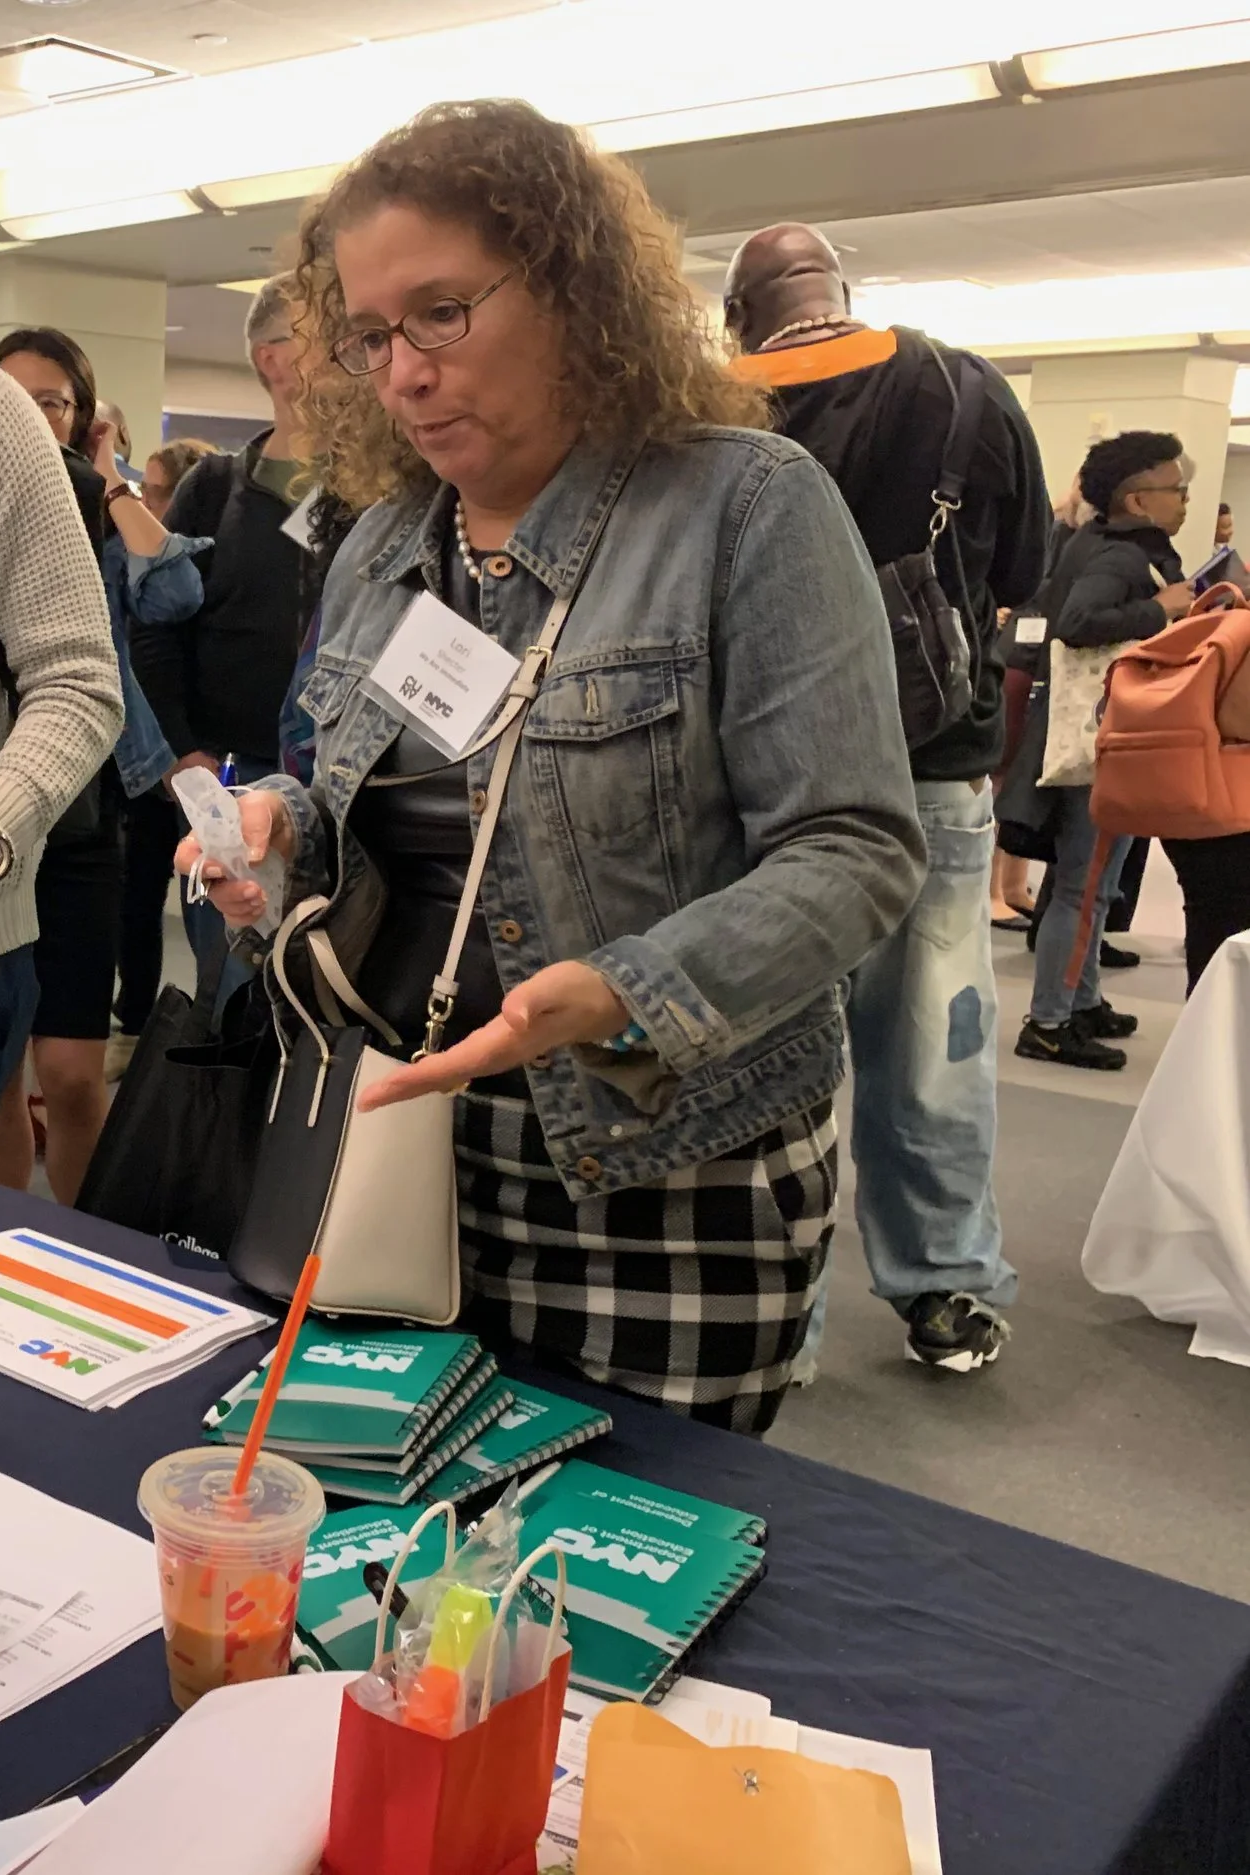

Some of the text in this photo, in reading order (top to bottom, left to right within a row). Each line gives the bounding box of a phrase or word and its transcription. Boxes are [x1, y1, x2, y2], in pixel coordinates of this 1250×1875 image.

[450, 637, 472, 658] Lori
[424, 692, 454, 718] NYC
[19, 1339, 102, 1376] NYC
[302, 1345, 414, 1373] NYC
[345, 1343, 419, 1357] Department
[362, 1340, 424, 1352] Education
[592, 1490, 693, 1528] Department of
[629, 1494, 699, 1521] Education
[316, 1525, 400, 1550] Department
[323, 1519, 392, 1540] Education
[620, 1528, 694, 1557] Education
[302, 1532, 420, 1579] NYC
[545, 1527, 680, 1584] NYC
[581, 1525, 688, 1564] Department of
